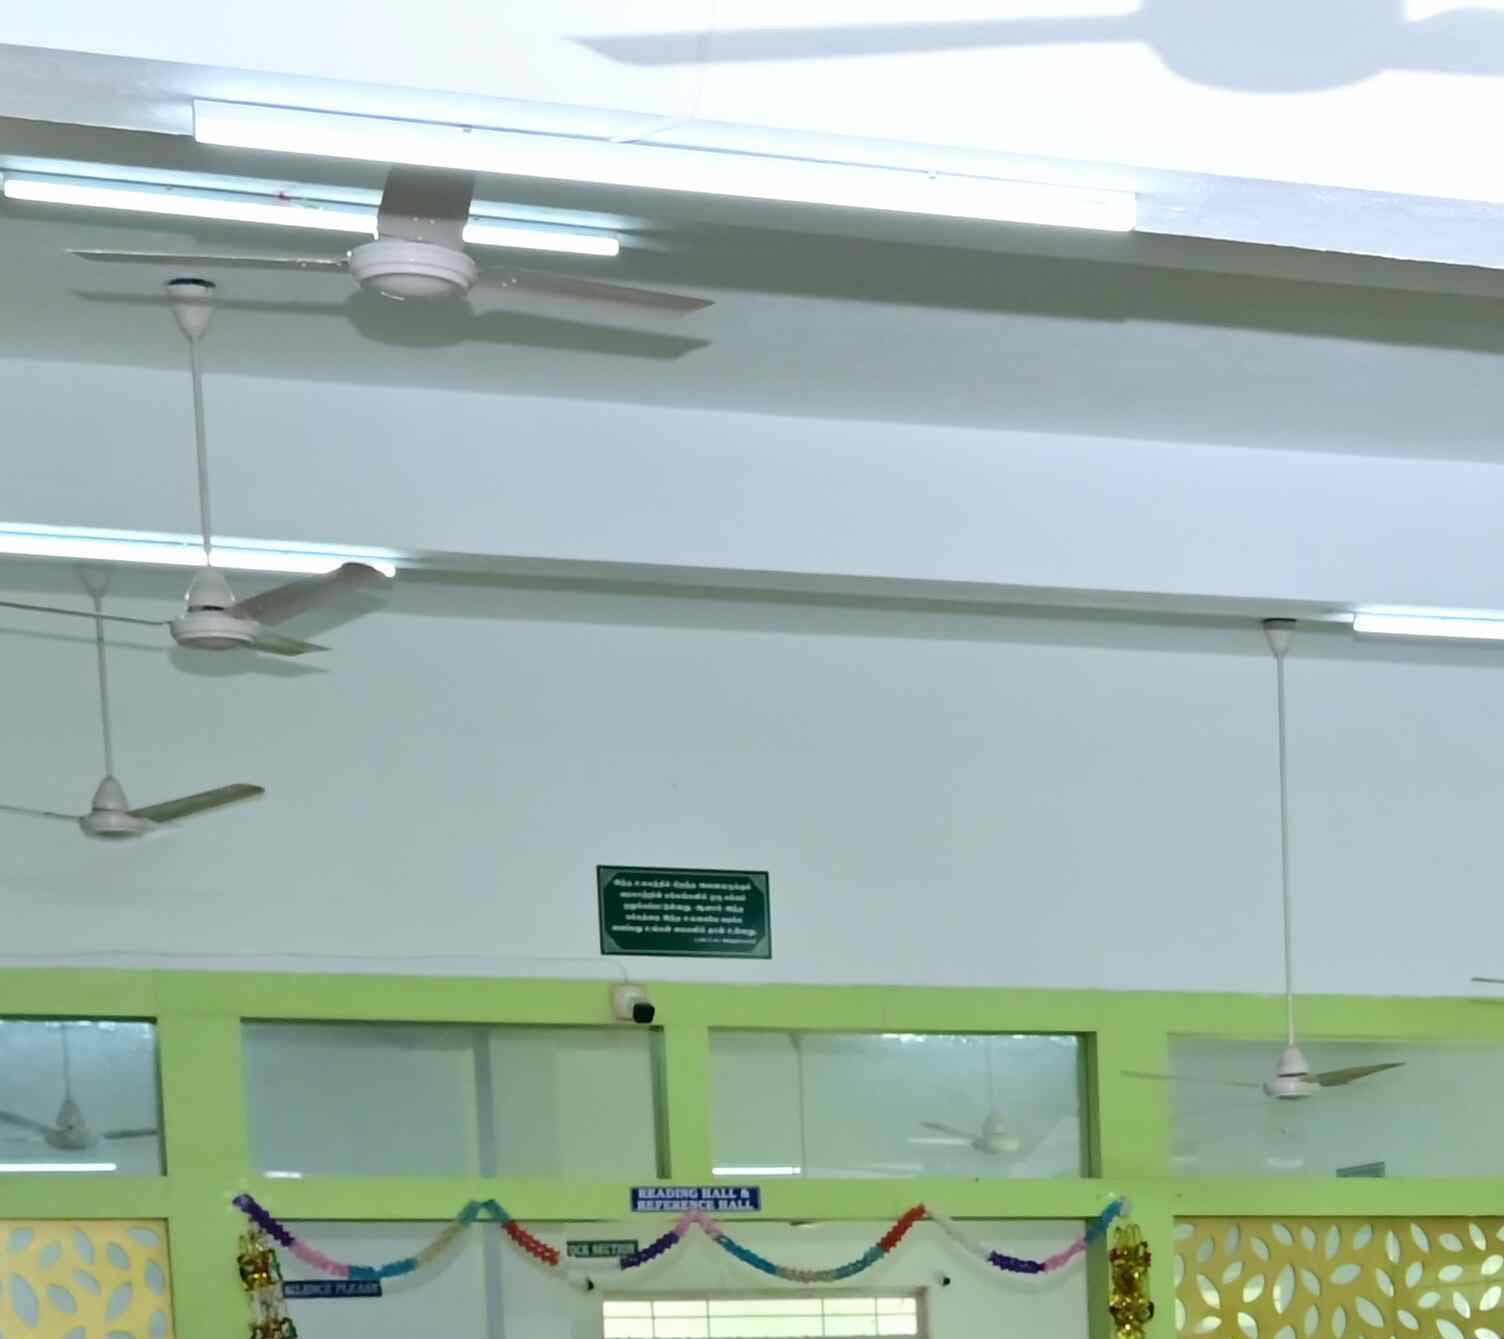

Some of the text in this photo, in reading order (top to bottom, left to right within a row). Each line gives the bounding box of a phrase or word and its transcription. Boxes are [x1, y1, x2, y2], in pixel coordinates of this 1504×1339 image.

[637, 1188, 698, 1199] READING
[701, 1189, 737, 1199] HALL
[636, 1200, 754, 1210] REFERENCE HALL
